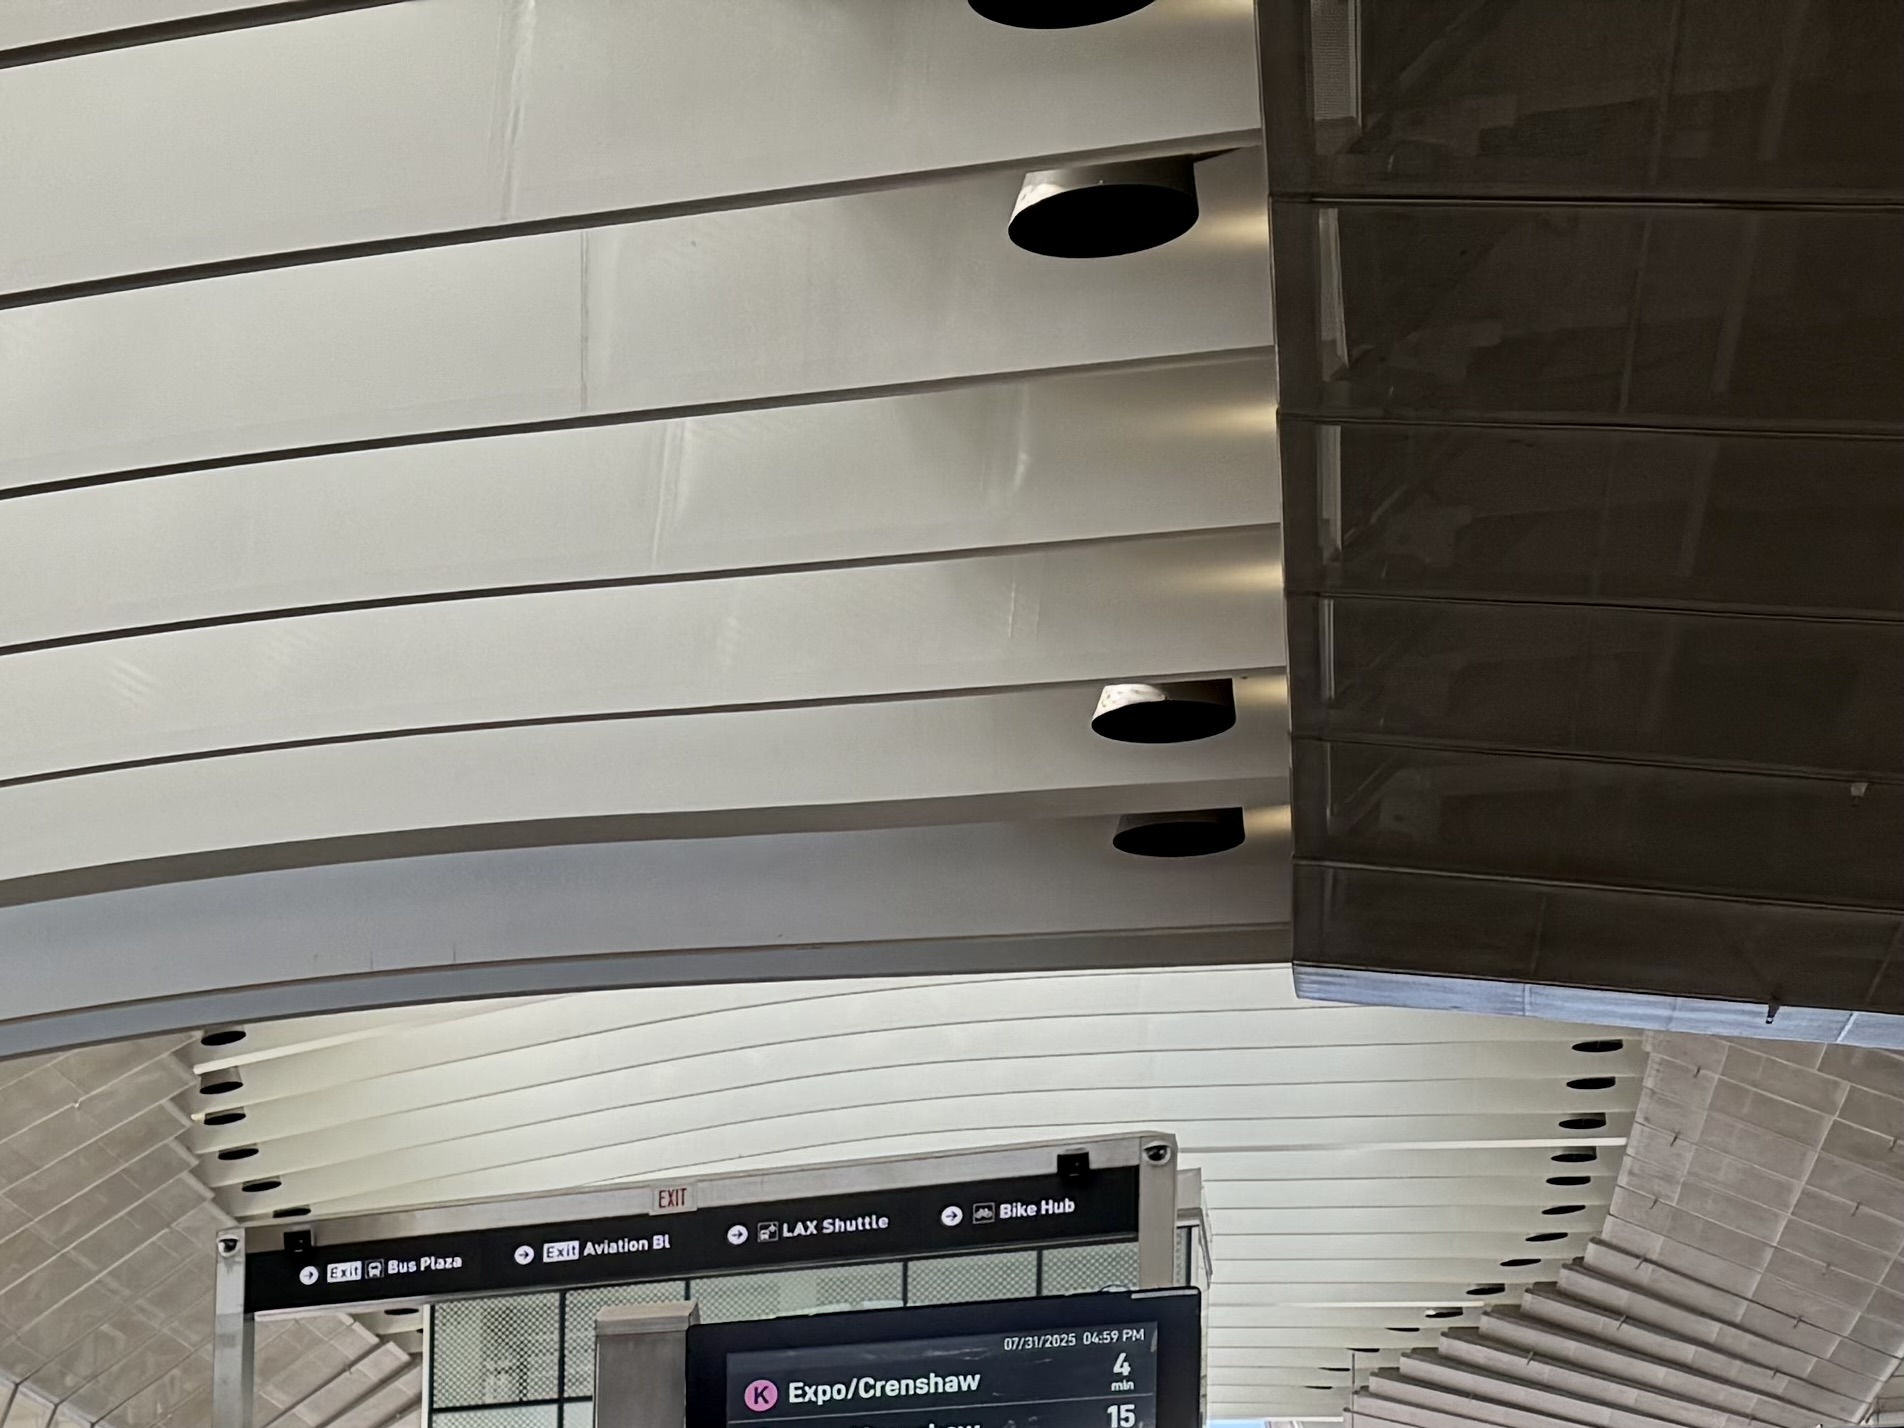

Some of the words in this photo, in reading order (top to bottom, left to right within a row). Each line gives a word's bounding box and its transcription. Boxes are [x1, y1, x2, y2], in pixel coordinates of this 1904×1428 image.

[658, 1188, 687, 1208] EXIT
[999, 1202, 1037, 1219] Bike
[1040, 1198, 1076, 1216] Hub
[783, 1219, 818, 1238] LAX
[822, 1215, 889, 1235] Shuttle
[546, 1243, 577, 1259] Exit
[583, 1237, 648, 1257] Aviation
[652, 1234, 671, 1250] Bl
[329, 1264, 359, 1280] Exit
[388, 1259, 416, 1274] Bus
[420, 1256, 462, 1272] Plaza
[1003, 1332, 1076, 1351] 07/31/2025
[1082, 1329, 1119, 1346] 04:59
[1122, 1327, 1145, 1342] PM
[1112, 1351, 1131, 1377] 4
[754, 1385, 769, 1405] K
[788, 1372, 981, 1405] Expo/Crenshaw
[1111, 1378, 1135, 1392] min
[1106, 1403, 1136, 1428] 15
